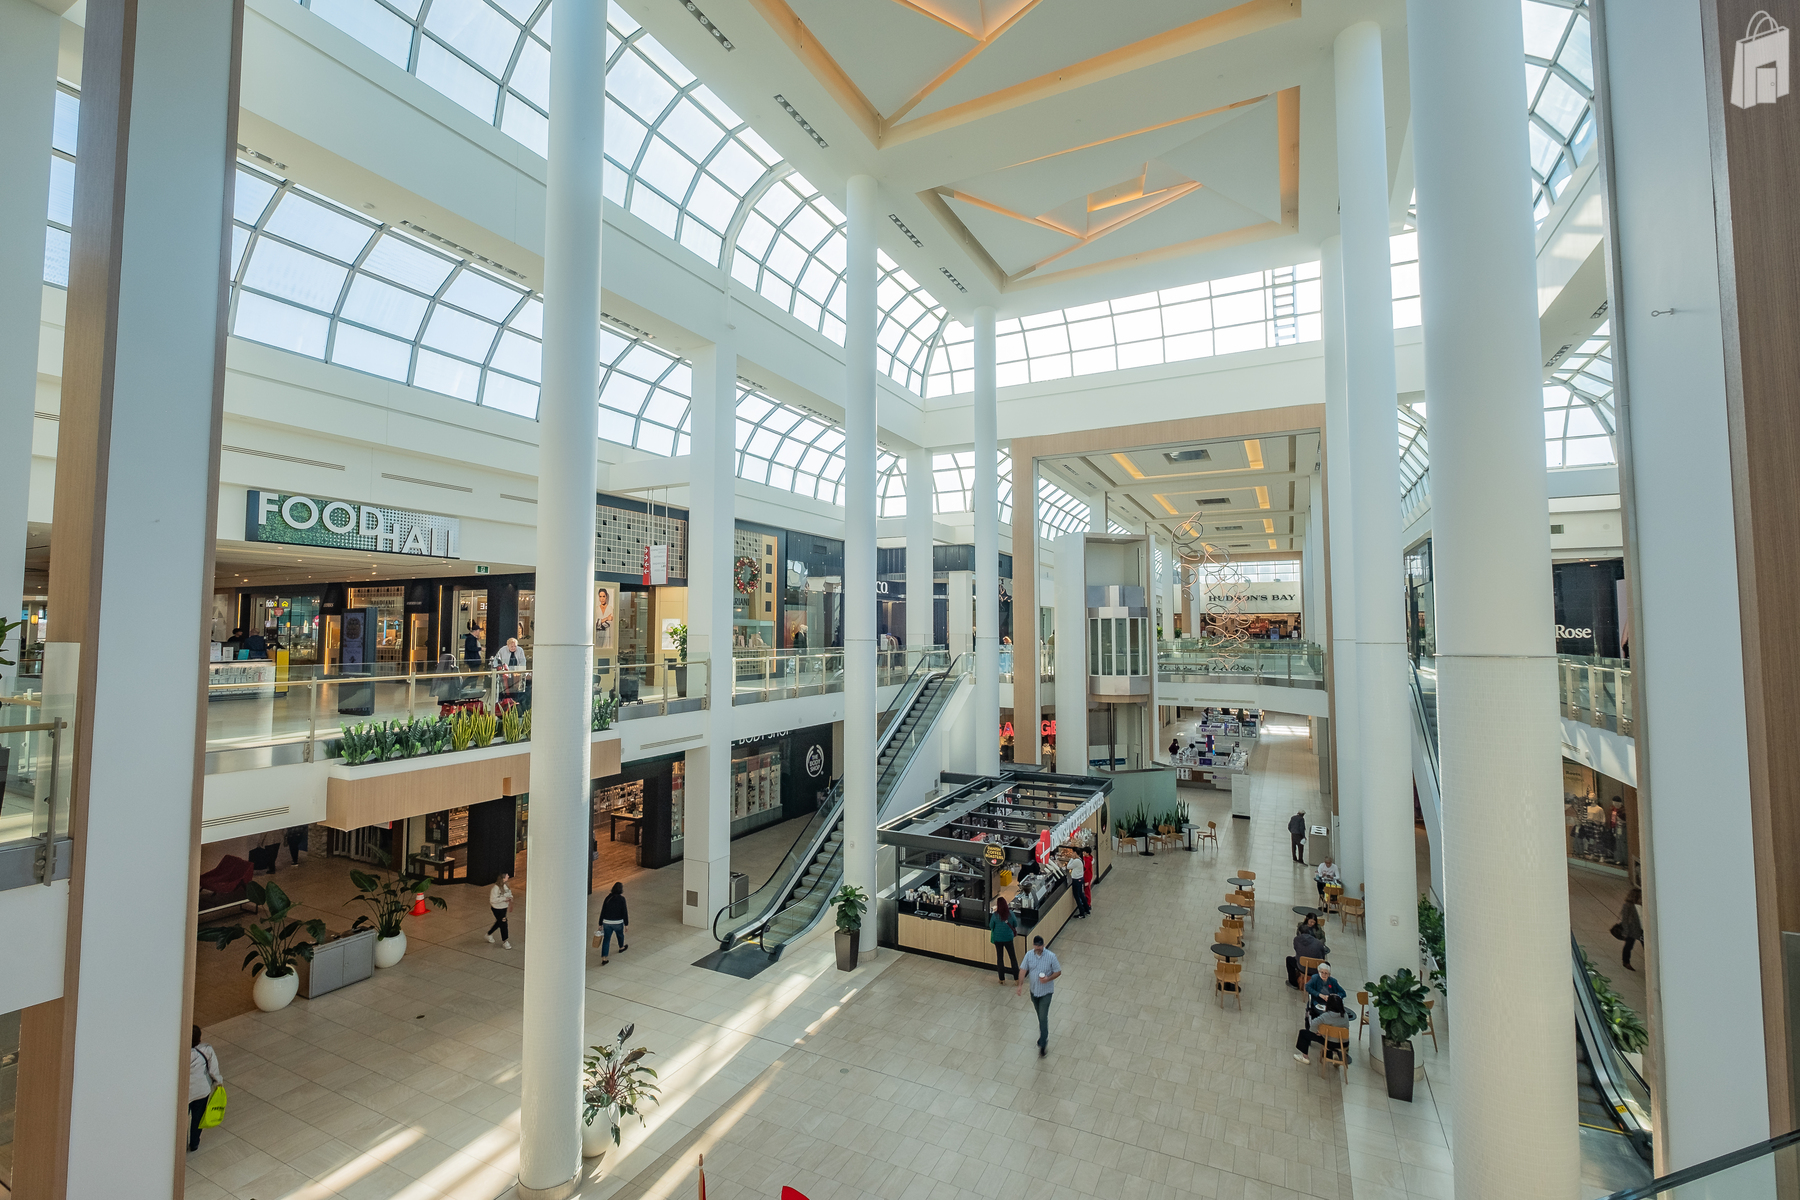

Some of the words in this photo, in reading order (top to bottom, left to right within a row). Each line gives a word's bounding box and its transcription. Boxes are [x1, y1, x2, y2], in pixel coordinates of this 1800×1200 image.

[733, 597, 750, 606] RIANI
[1208, 594, 1268, 602] HUDSON'S
[1272, 594, 1295, 602] BAY
[1555, 624, 1592, 639] Rose
